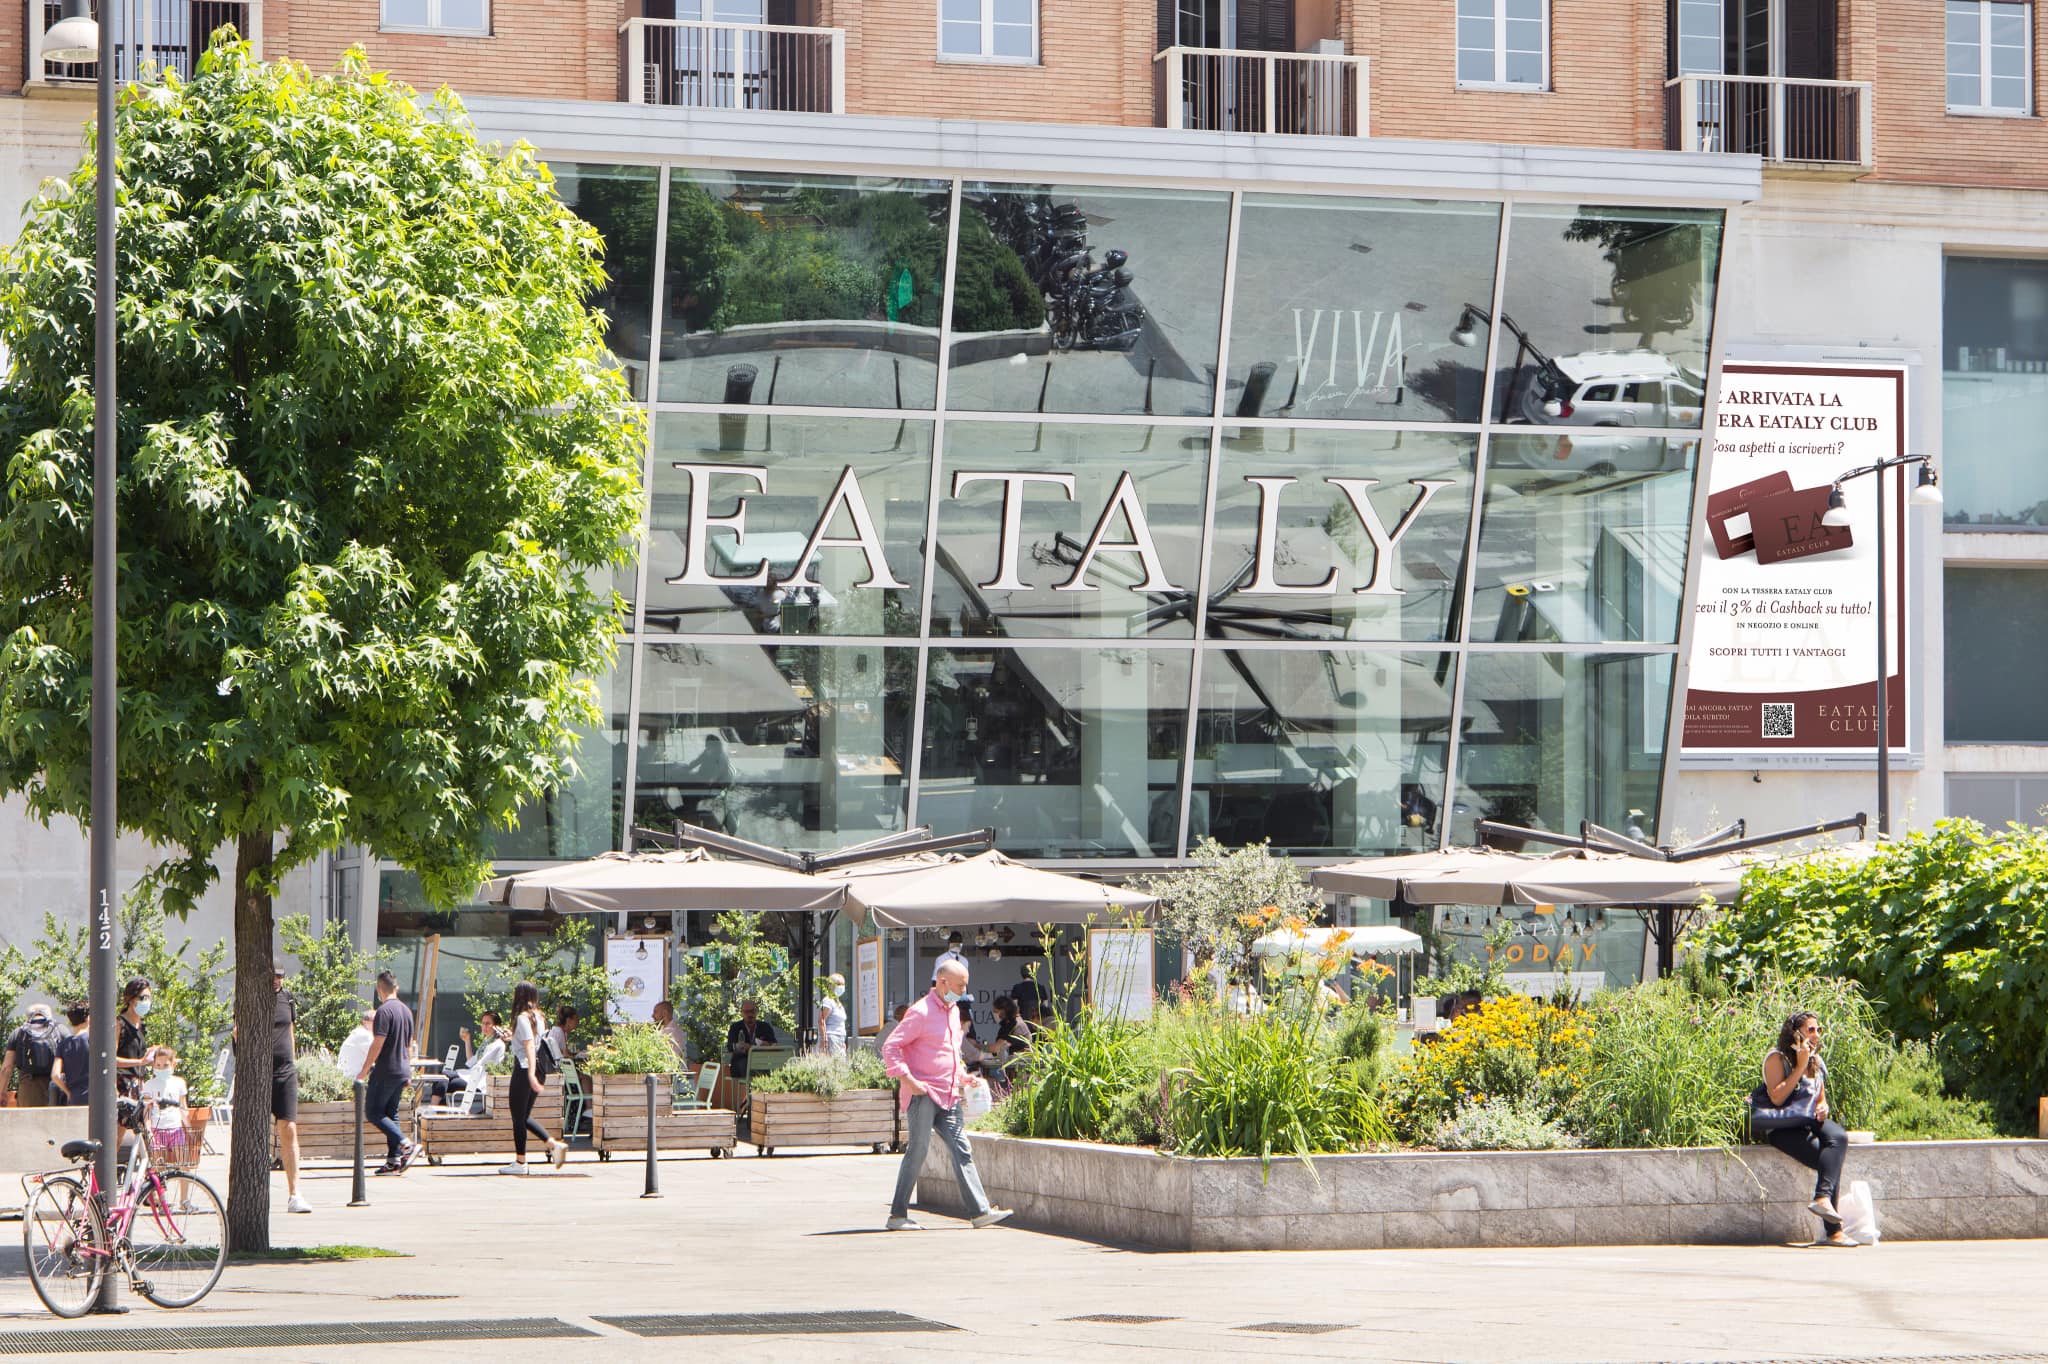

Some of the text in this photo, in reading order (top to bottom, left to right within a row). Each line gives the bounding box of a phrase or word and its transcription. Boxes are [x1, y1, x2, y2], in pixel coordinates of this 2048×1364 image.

[1292, 308, 1406, 388] VIVA
[1726, 390, 1816, 407] ARRIVATA
[1819, 392, 1843, 407] LA
[1718, 413, 1878, 431] ERA EATALY CLUB
[1739, 441, 1776, 457] aspetti
[1779, 444, 1785, 454] a
[1788, 441, 1845, 455] iscriverti?
[664, 461, 1458, 596] EATALY
[1722, 587, 1739, 595] CON
[1741, 587, 1750, 595] LA
[1752, 587, 1783, 595] TESSERA
[1695, 599, 1872, 616] cevi il 3% di Cashback su tutto!
[1709, 647, 1748, 657] SCOPRI
[1750, 648, 1782, 657] TUTTI
[1793, 648, 1846, 657] VANTAGGI
[1484, 943, 1597, 963] TODAY
